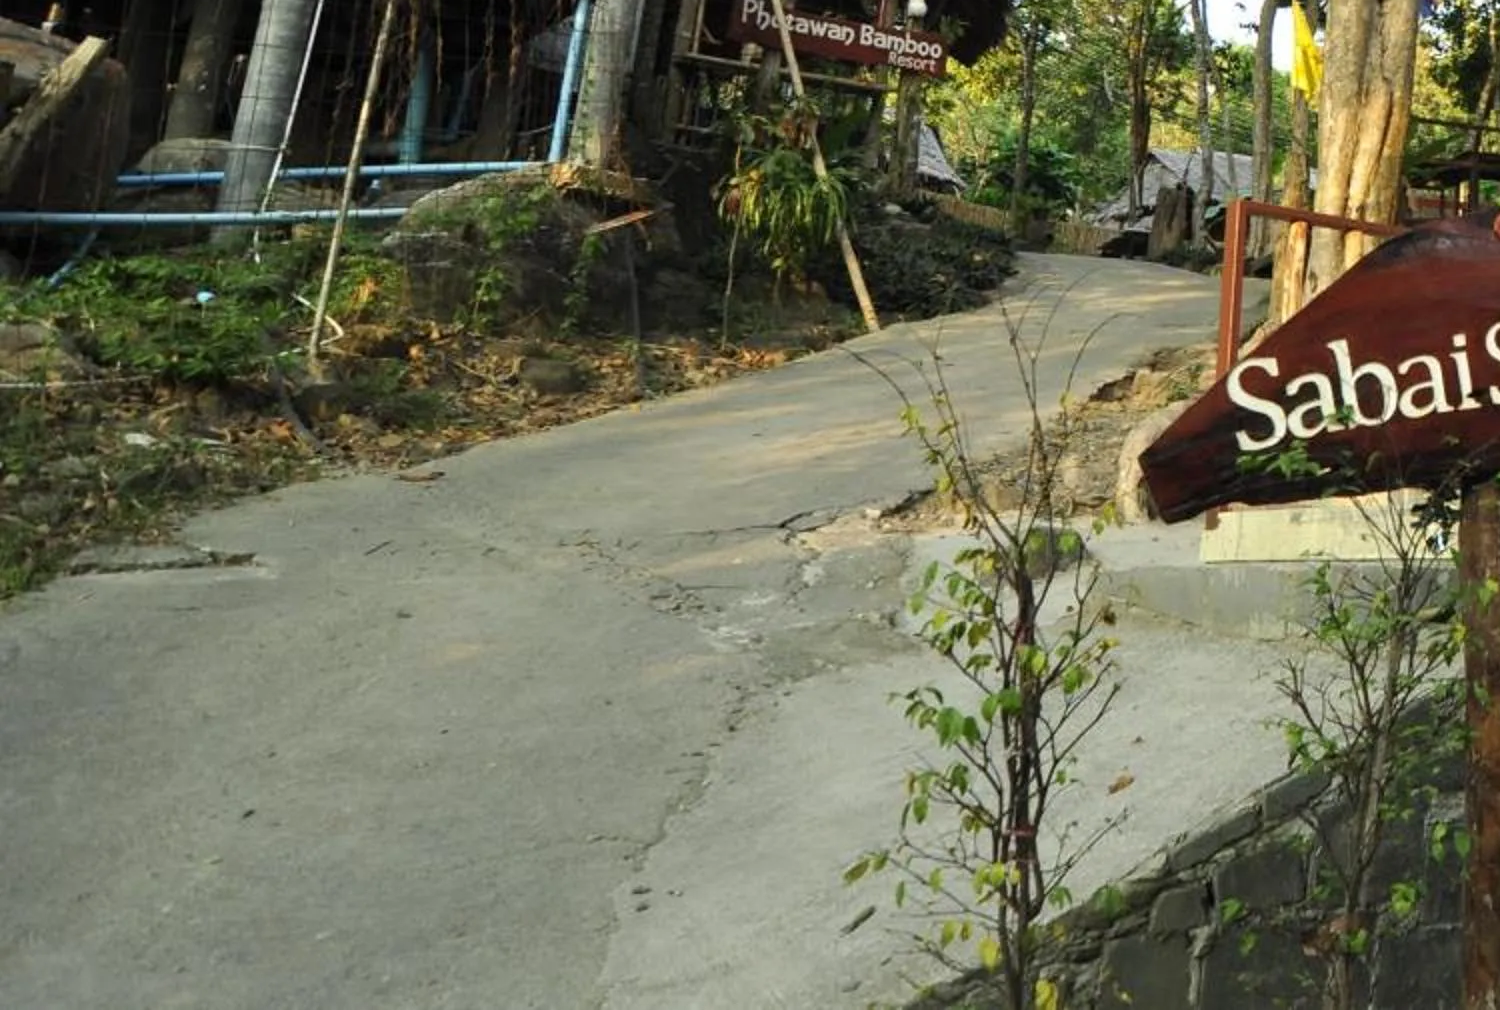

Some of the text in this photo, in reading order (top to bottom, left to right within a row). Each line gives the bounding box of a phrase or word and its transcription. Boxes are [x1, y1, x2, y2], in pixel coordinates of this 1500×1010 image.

[859, 24, 943, 58] Bamboo
[888, 52, 936, 71] Resort
[1226, 333, 1482, 452] Sabai
